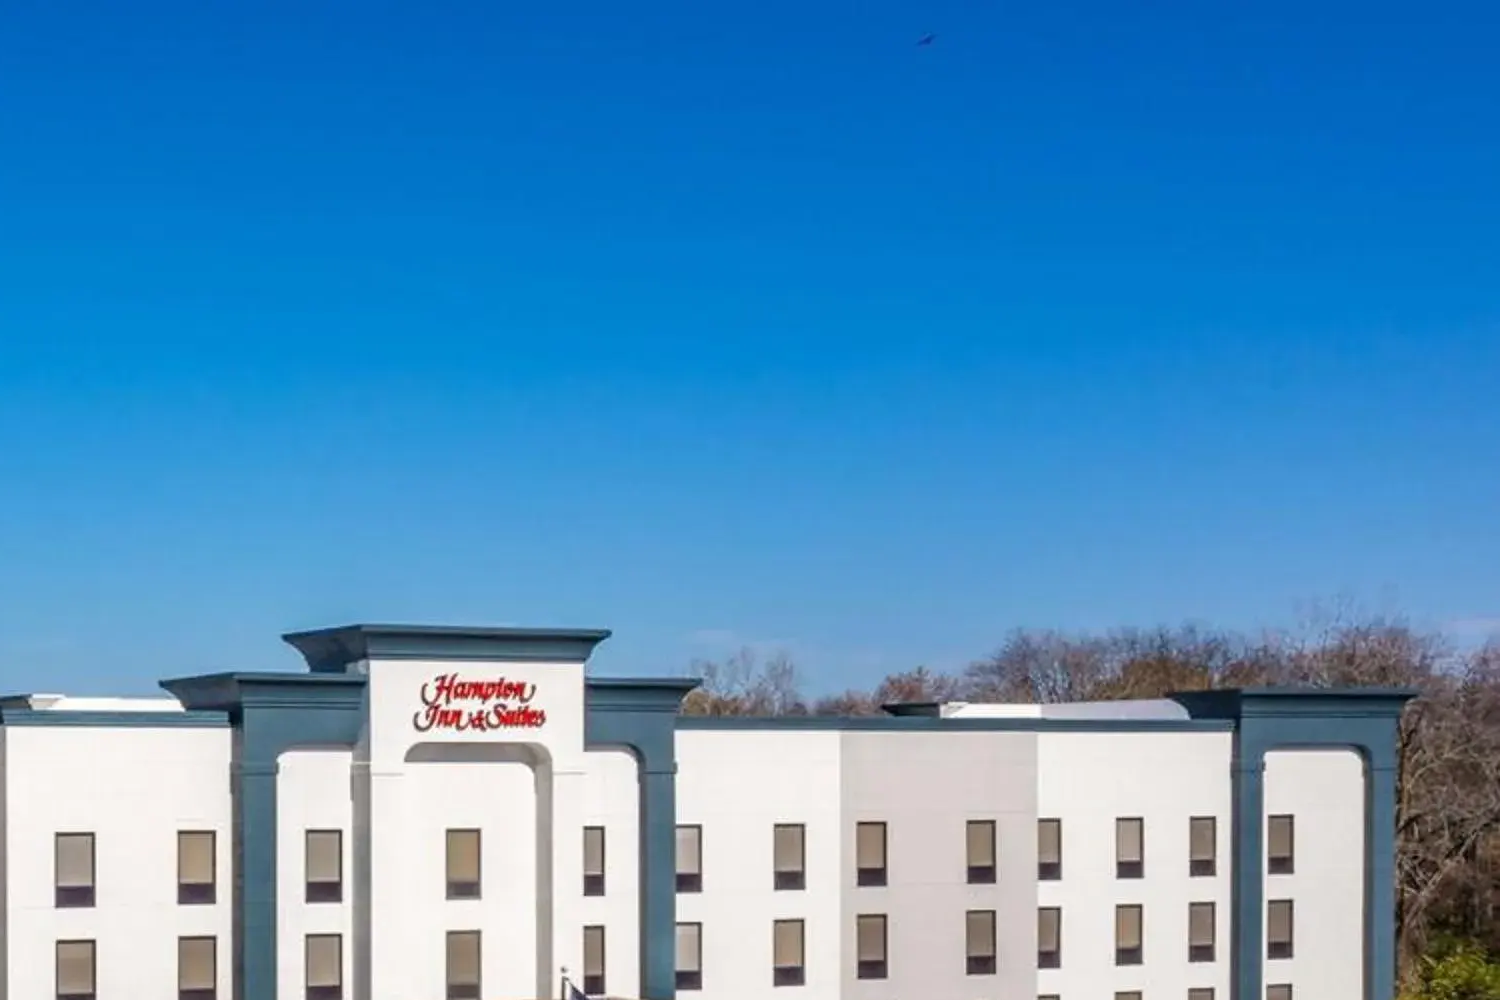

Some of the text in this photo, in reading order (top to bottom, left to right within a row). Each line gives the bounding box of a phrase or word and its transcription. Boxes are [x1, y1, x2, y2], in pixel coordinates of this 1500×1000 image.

[421, 672, 537, 706] Hampton
[413, 703, 547, 732] Inn & Suites
